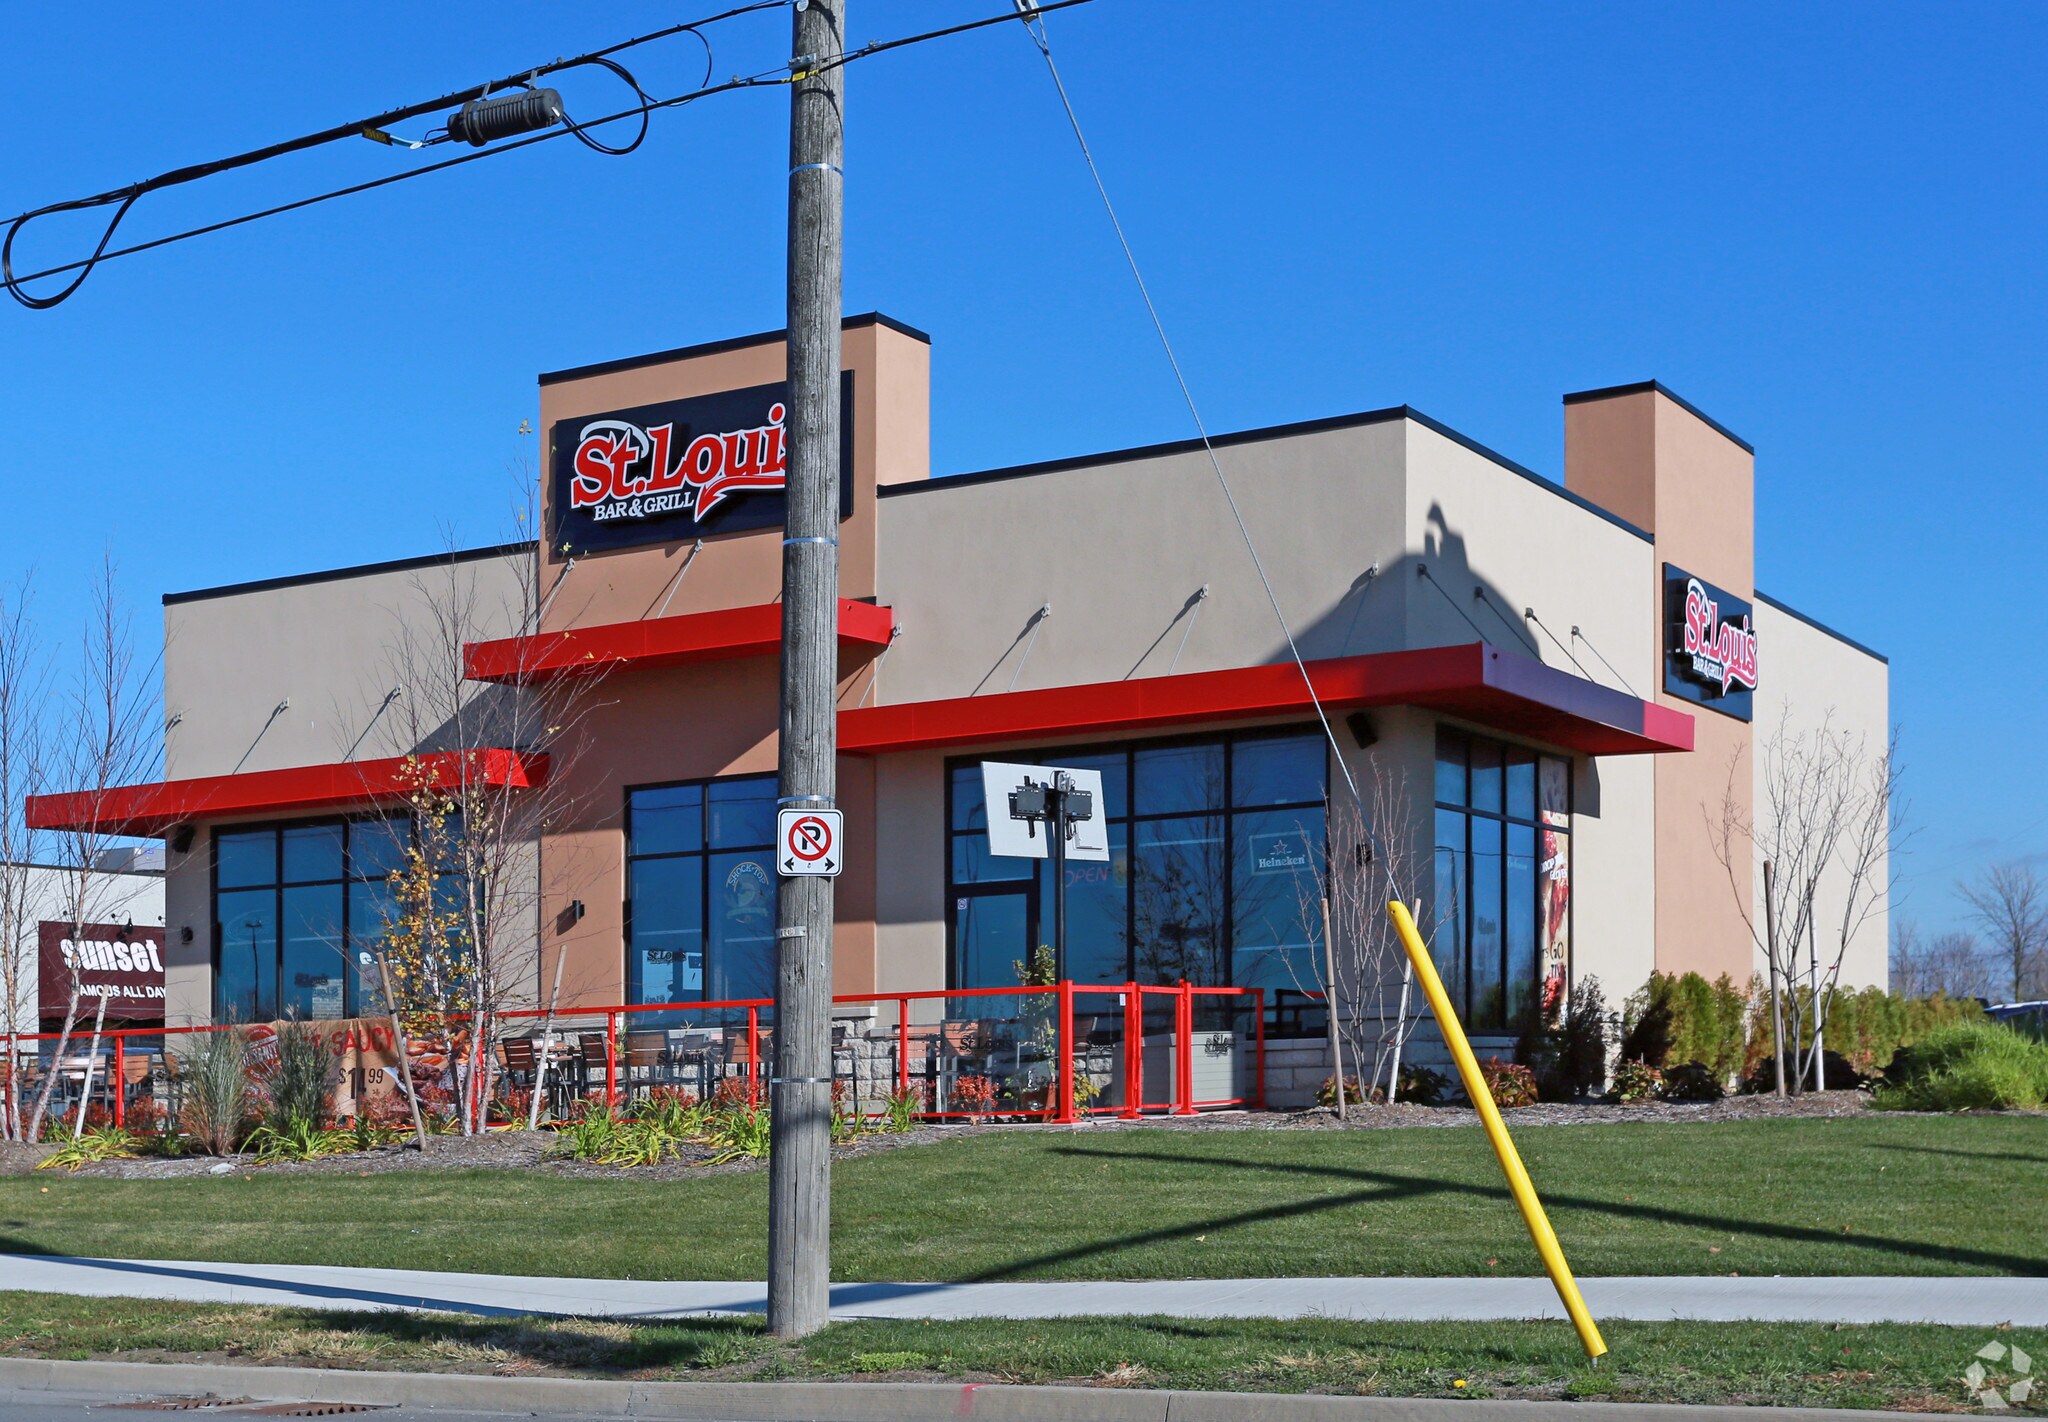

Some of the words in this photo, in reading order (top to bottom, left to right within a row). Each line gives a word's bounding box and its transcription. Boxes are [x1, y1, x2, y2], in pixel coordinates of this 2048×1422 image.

[570, 402, 787, 509] St.Loui
[1259, 856, 1305, 868] Heineken
[78, 984, 121, 997] AMOUS
[123, 985, 145, 998] ALL
[331, 1026, 394, 1057] SAUCY
